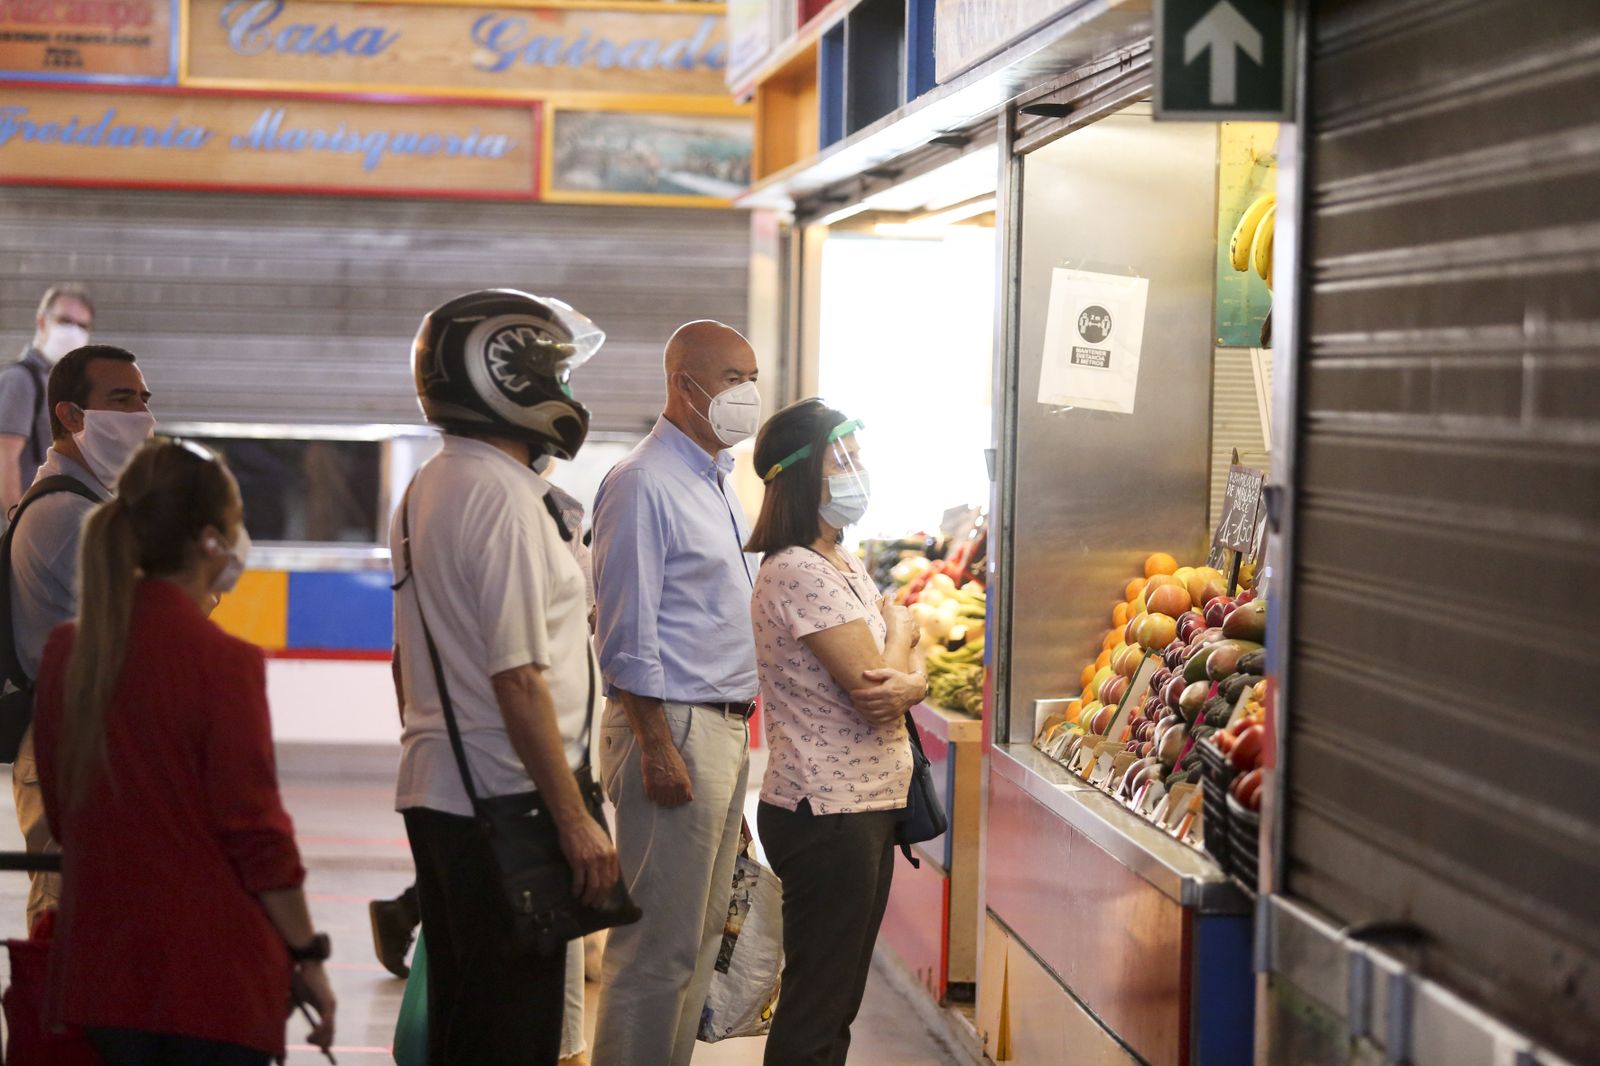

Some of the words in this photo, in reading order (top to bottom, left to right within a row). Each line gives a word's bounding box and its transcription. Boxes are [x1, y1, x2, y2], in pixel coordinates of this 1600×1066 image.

[219, 0, 400, 56] Casa
[1075, 347, 1107, 357] MANTENER
[1080, 358, 1105, 367] METROS
